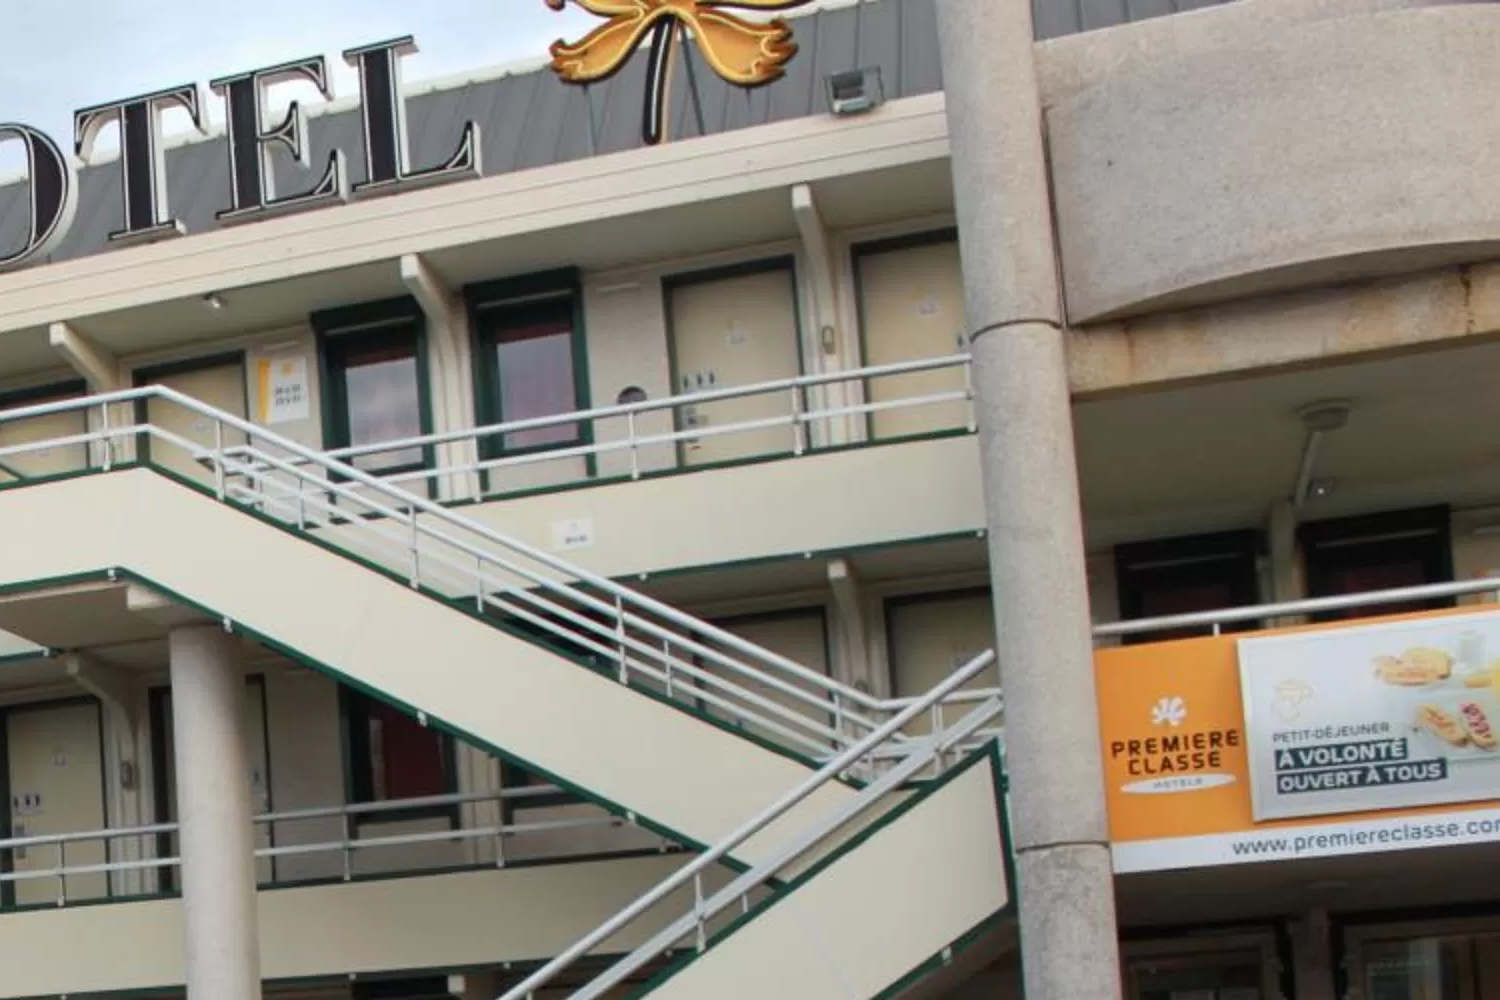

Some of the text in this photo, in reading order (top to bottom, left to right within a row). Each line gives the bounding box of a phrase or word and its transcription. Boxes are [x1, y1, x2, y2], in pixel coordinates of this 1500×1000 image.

[1111, 729, 1240, 759] PREMIERE
[1272, 721, 1390, 743] PETIT-DÉJEUNER
[1127, 751, 1221, 775] CLASSE
[1279, 738, 1405, 769] À VOLONTÉ
[1280, 762, 1441, 792] OUVERT À TOUS
[1232, 818, 1500, 857] www.premiereclasse.co
